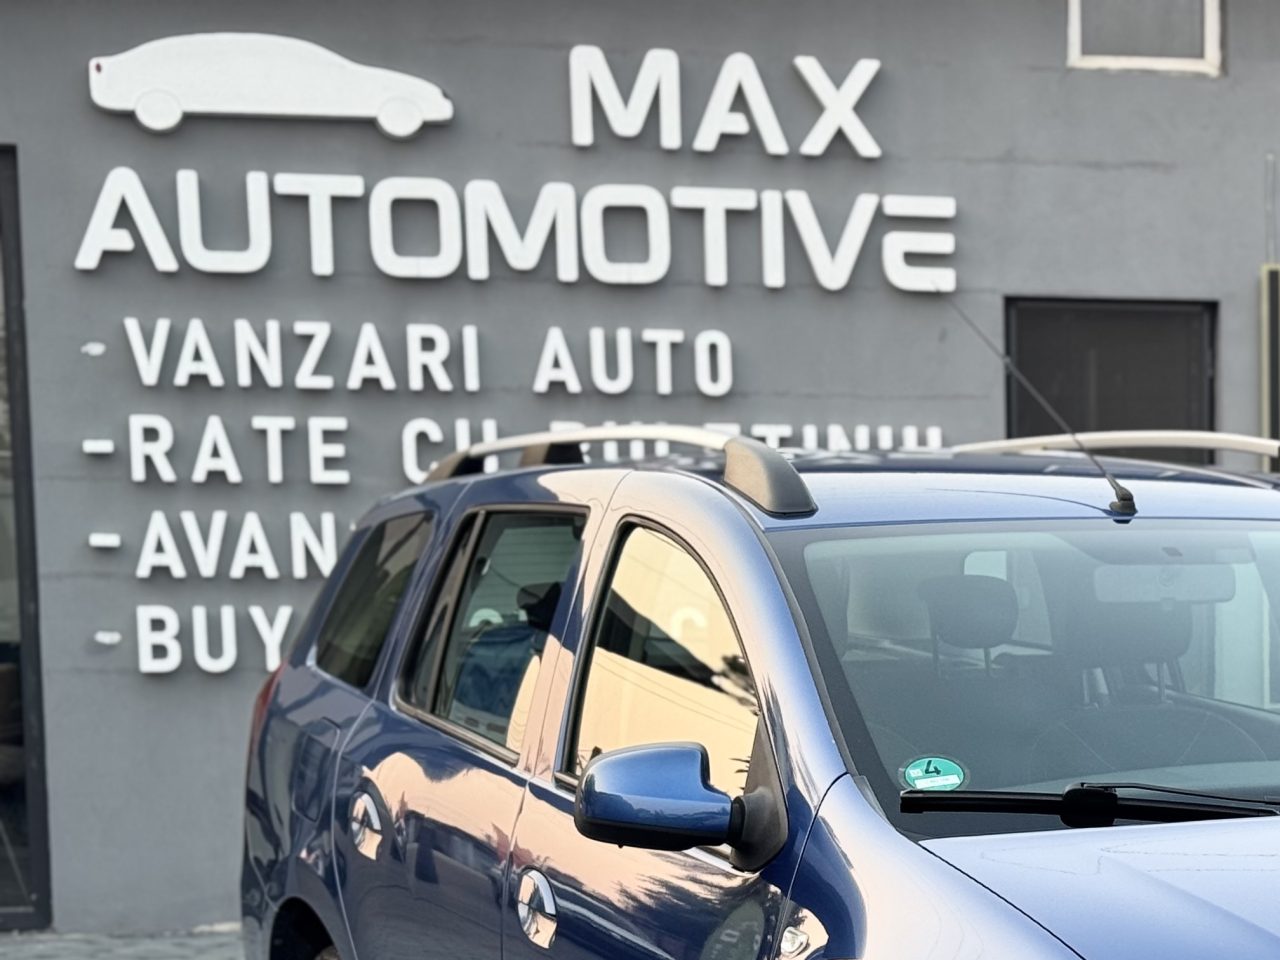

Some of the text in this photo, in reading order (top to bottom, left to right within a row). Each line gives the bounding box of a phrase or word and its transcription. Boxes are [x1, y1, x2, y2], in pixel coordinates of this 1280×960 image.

[569, 44, 882, 159] MAX
[74, 166, 956, 294] AUTOMOTIVE
[532, 326, 733, 396] AUTO
[924, 759, 941, 775] 4
